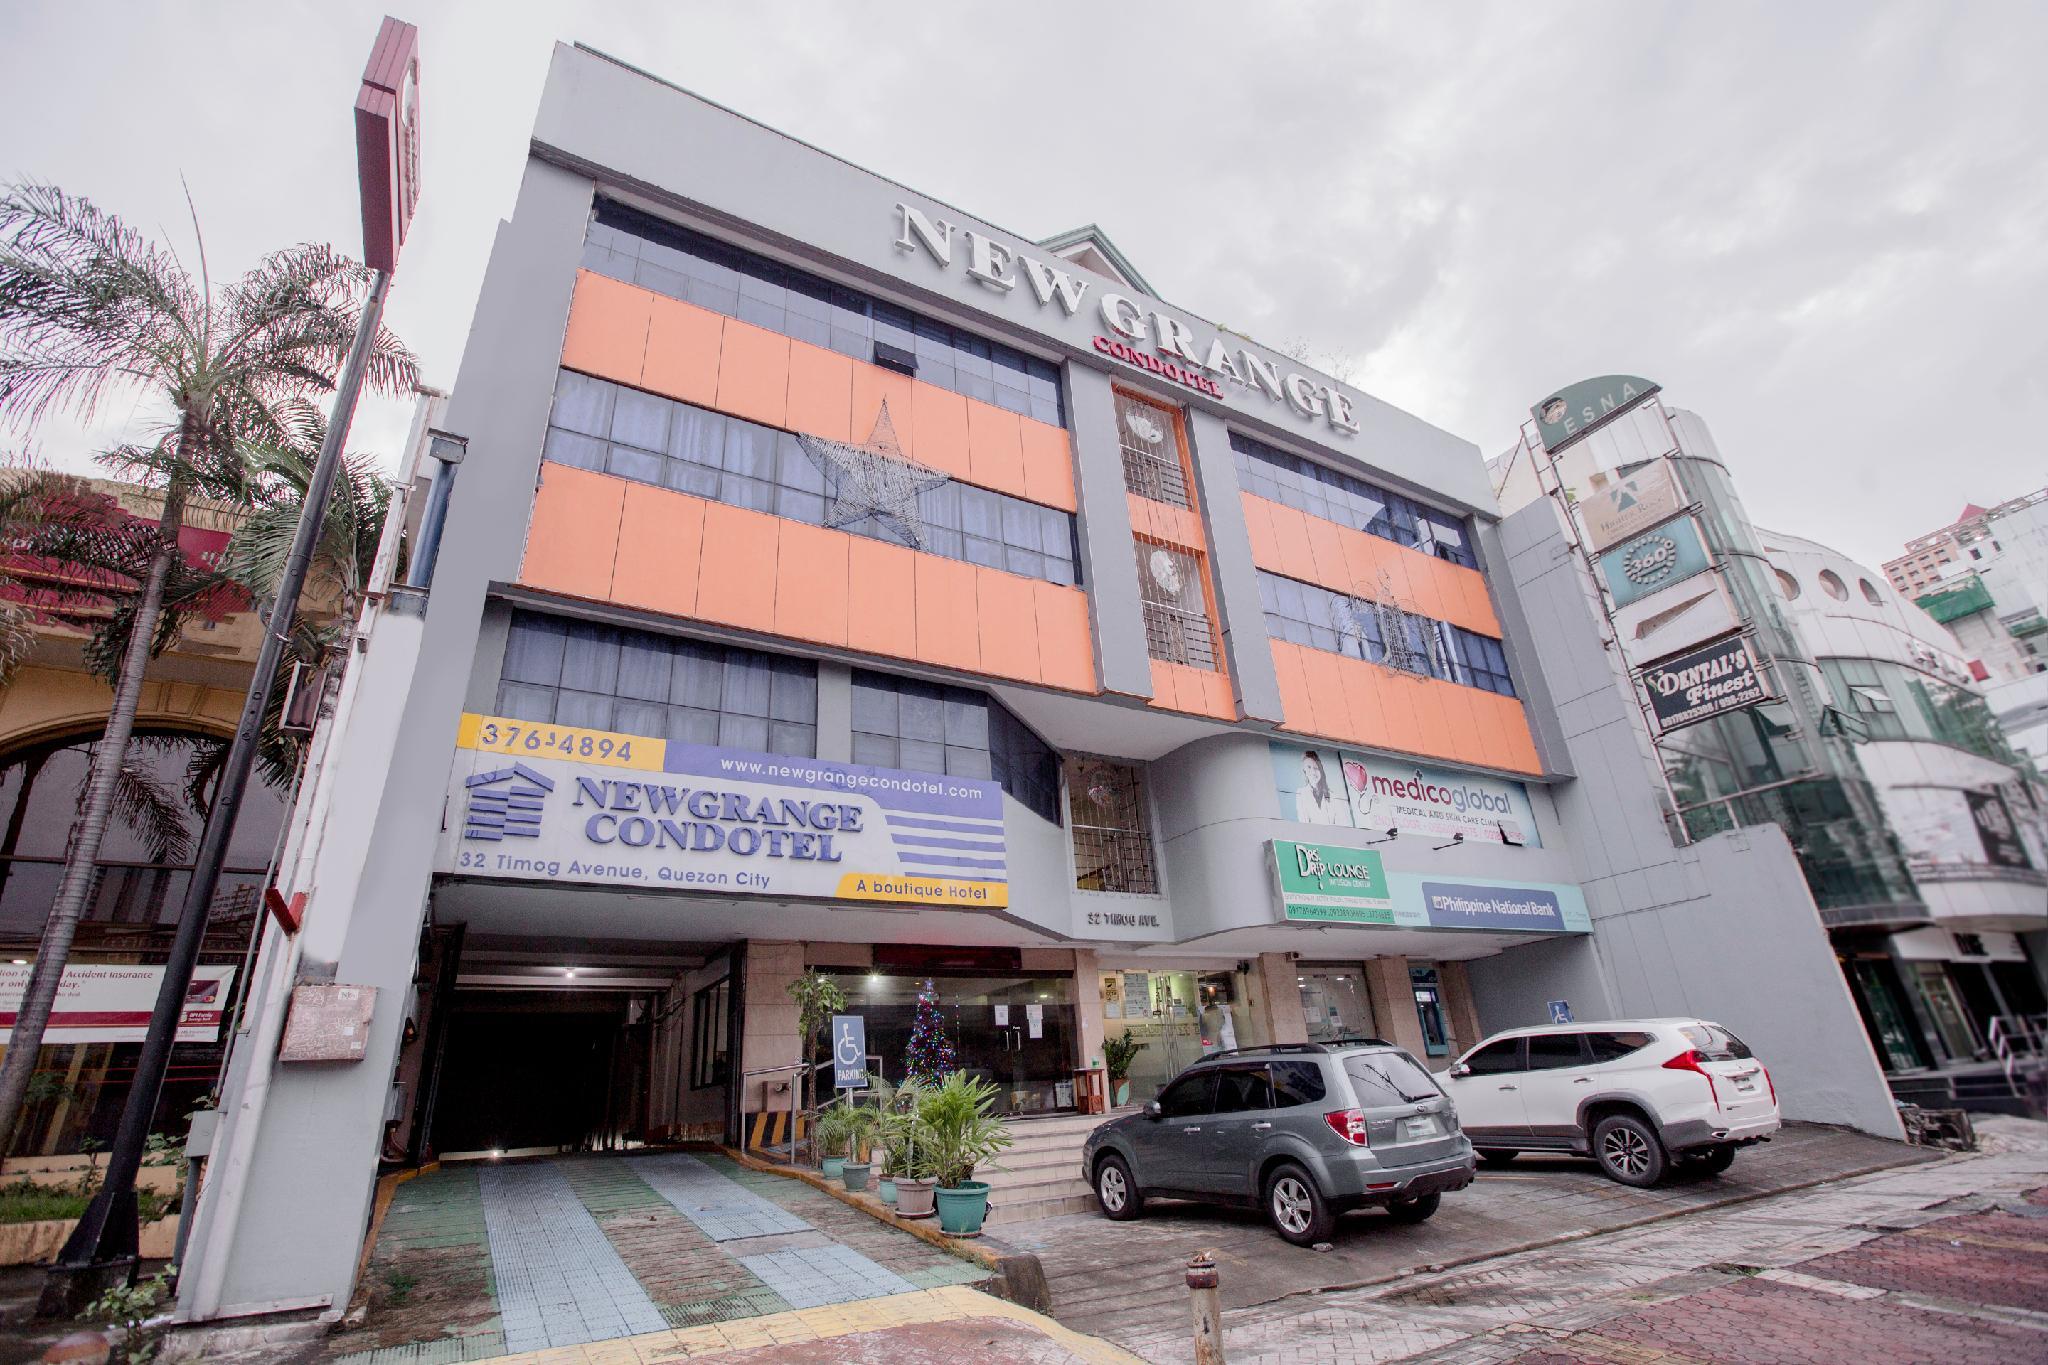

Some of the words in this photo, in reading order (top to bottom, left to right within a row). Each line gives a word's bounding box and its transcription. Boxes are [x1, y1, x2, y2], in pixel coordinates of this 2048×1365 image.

[895, 202, 1089, 315] NEW
[1099, 293, 1361, 435] GRANGE
[1093, 335, 1224, 399] CONDOTEL
[1563, 382, 1637, 434] ESNA
[1657, 649, 1747, 696] DENTAL'S
[1686, 670, 1754, 706] Finest
[721, 759, 983, 800] www.newgrangecondotel.com
[1371, 769, 1512, 814] medicoglobal
[572, 776, 864, 832] NEWGRANGE
[585, 813, 842, 862] CONDOTEL
[460, 851, 486, 868] 32
[497, 854, 560, 875] Timog
[568, 860, 649, 880] Avenue,
[657, 867, 728, 884] Quezon
[736, 872, 770, 889] City
[857, 879, 866, 893] A
[874, 880, 942, 897] boutique
[949, 883, 987, 899] Hotel
[1327, 862, 1370, 880] LOUNGE
[1442, 896, 1491, 915] Philippine
[1492, 899, 1531, 915] National
[1531, 901, 1555, 916] Bank
[66, 970, 107, 979] Accident
[109, 971, 153, 979] Insurance
